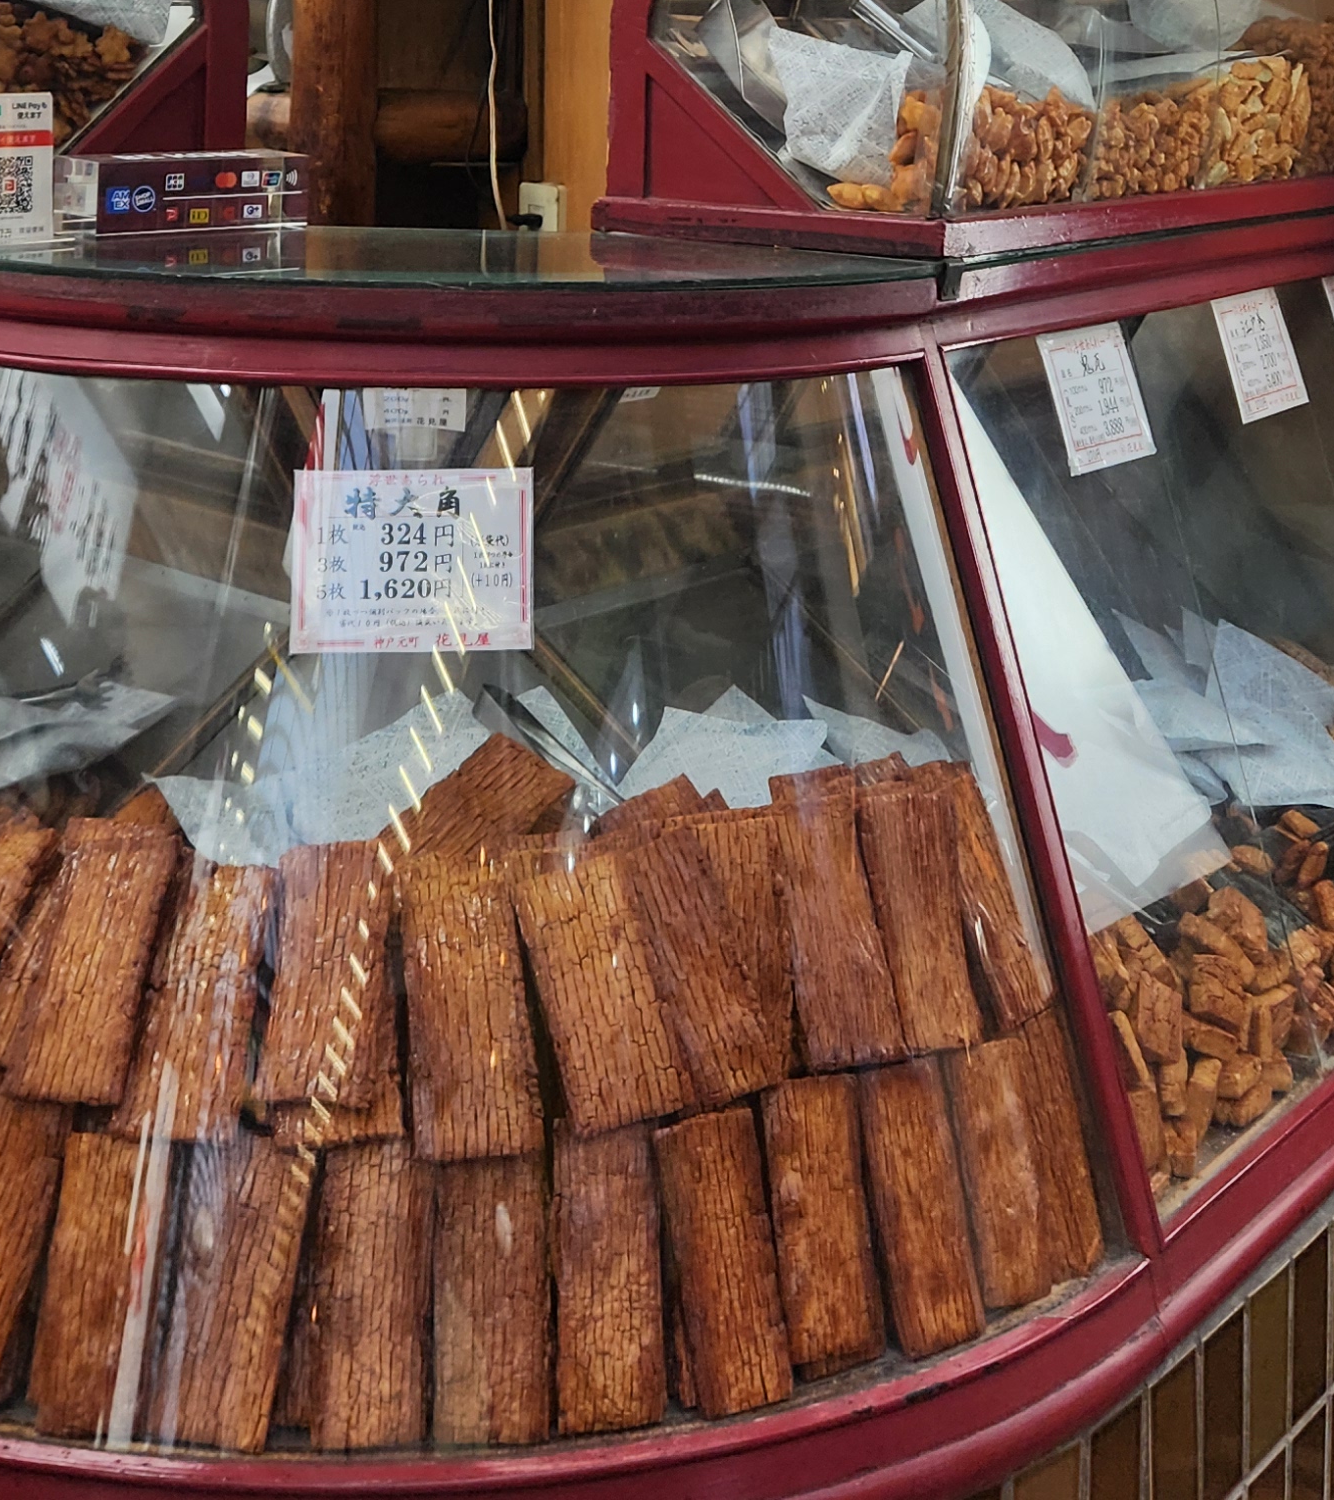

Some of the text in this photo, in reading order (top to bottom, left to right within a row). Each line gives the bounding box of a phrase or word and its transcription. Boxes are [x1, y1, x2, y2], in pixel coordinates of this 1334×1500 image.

[317, 524, 348, 545] 1枚
[380, 522, 454, 547] 324円
[317, 551, 452, 573] 3枚 972円
[316, 578, 451, 601] 5枚 1,620円
[374, 635, 420, 649] 神戸元町
